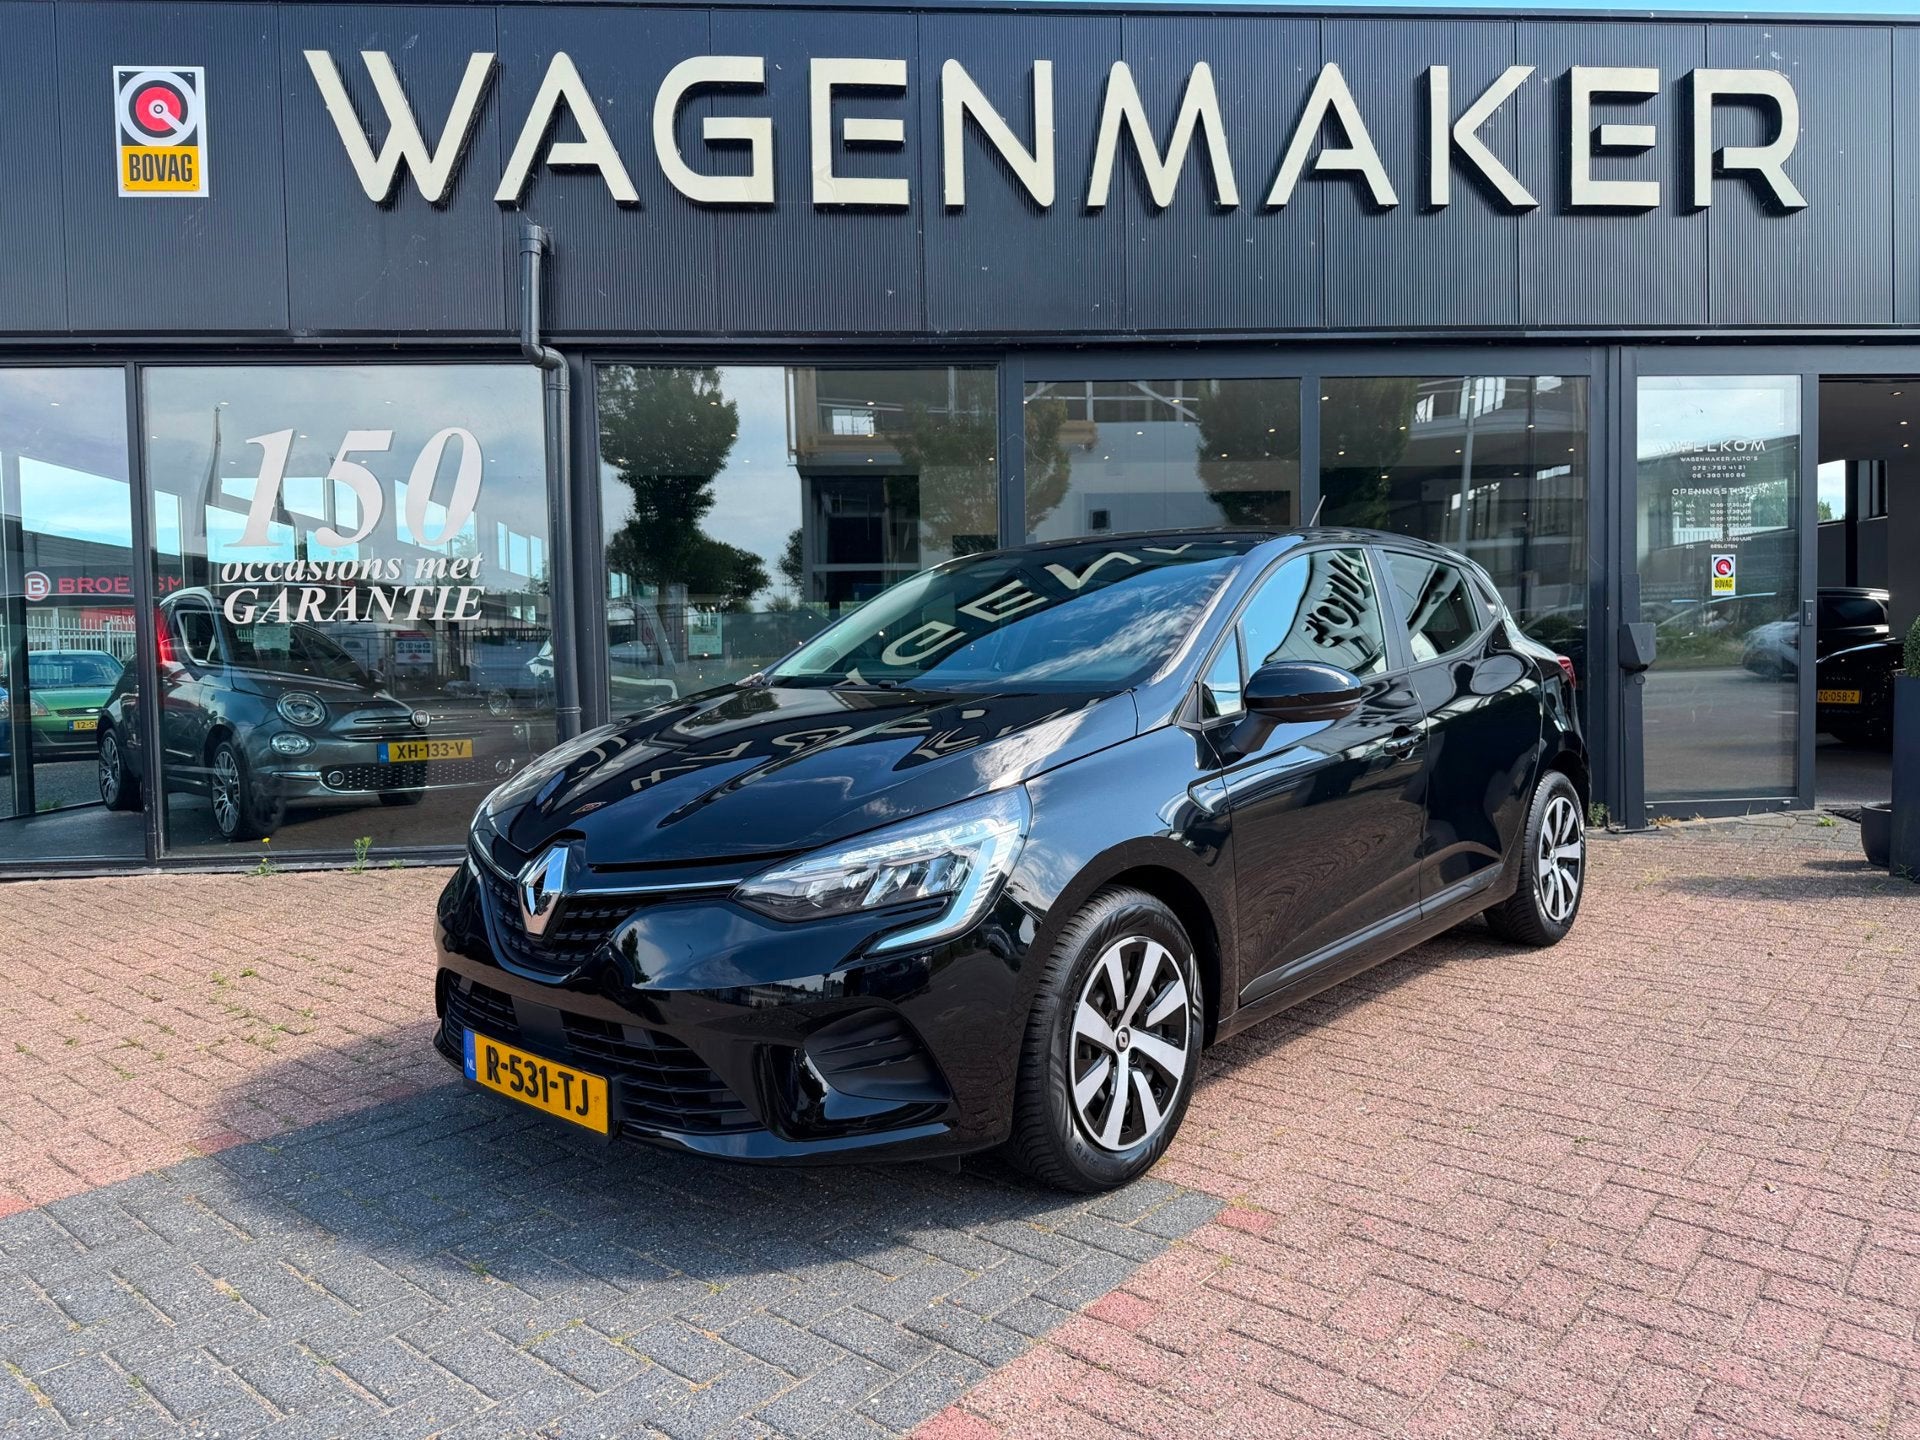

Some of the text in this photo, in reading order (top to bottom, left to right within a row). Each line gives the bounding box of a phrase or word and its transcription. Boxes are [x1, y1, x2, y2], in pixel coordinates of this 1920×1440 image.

[303, 50, 1808, 207] WAGENMAKER
[128, 153, 193, 182] BOVAG
[223, 427, 484, 547] 150
[221, 549, 484, 582] occasions met
[1714, 578, 1733, 588] BOVAG
[223, 585, 486, 625] GARANTIE
[397, 742, 464, 759] XH-133-V
[466, 1044, 589, 1116] NL R-531-TJ
